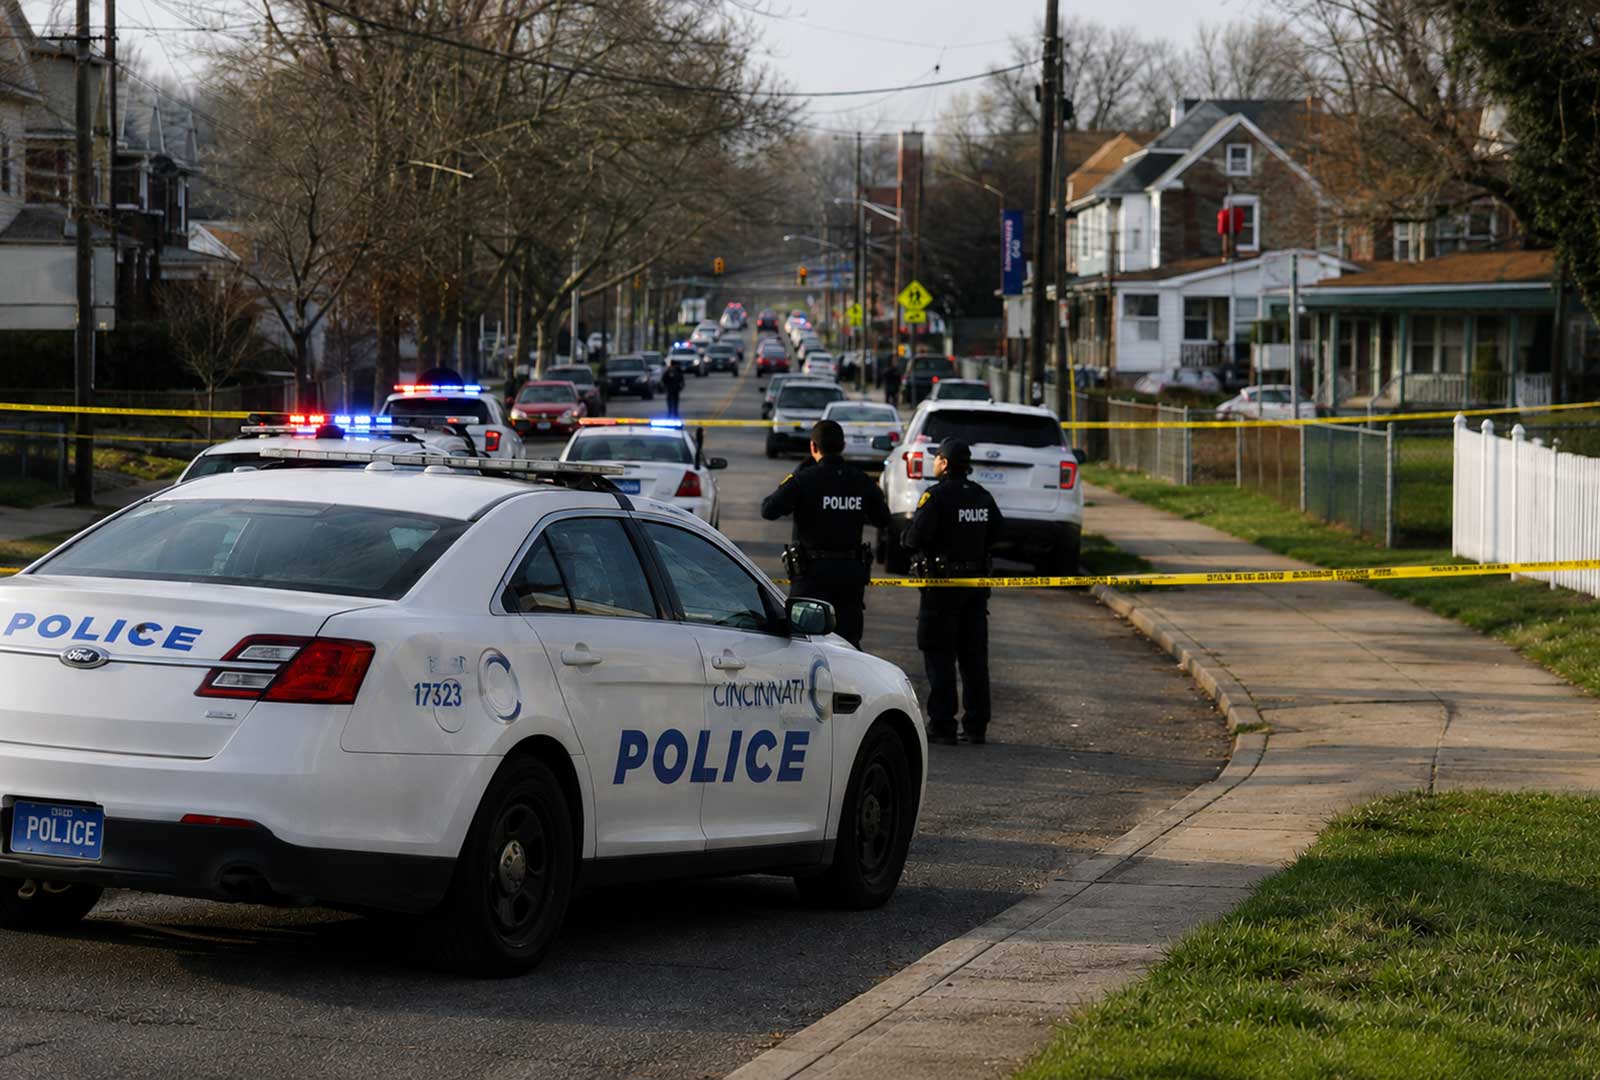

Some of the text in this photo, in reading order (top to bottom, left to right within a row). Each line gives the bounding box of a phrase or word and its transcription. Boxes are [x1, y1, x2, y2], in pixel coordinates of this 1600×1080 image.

[822, 495, 863, 511] POLICE
[958, 508, 989, 523] POLICE
[4, 613, 203, 651] POLICE
[67, 649, 94, 662] Ford
[414, 682, 462, 707] 17323
[713, 680, 804, 707] CINCINNATI
[613, 728, 810, 785] POLICE
[26, 815, 97, 846] POLICE
